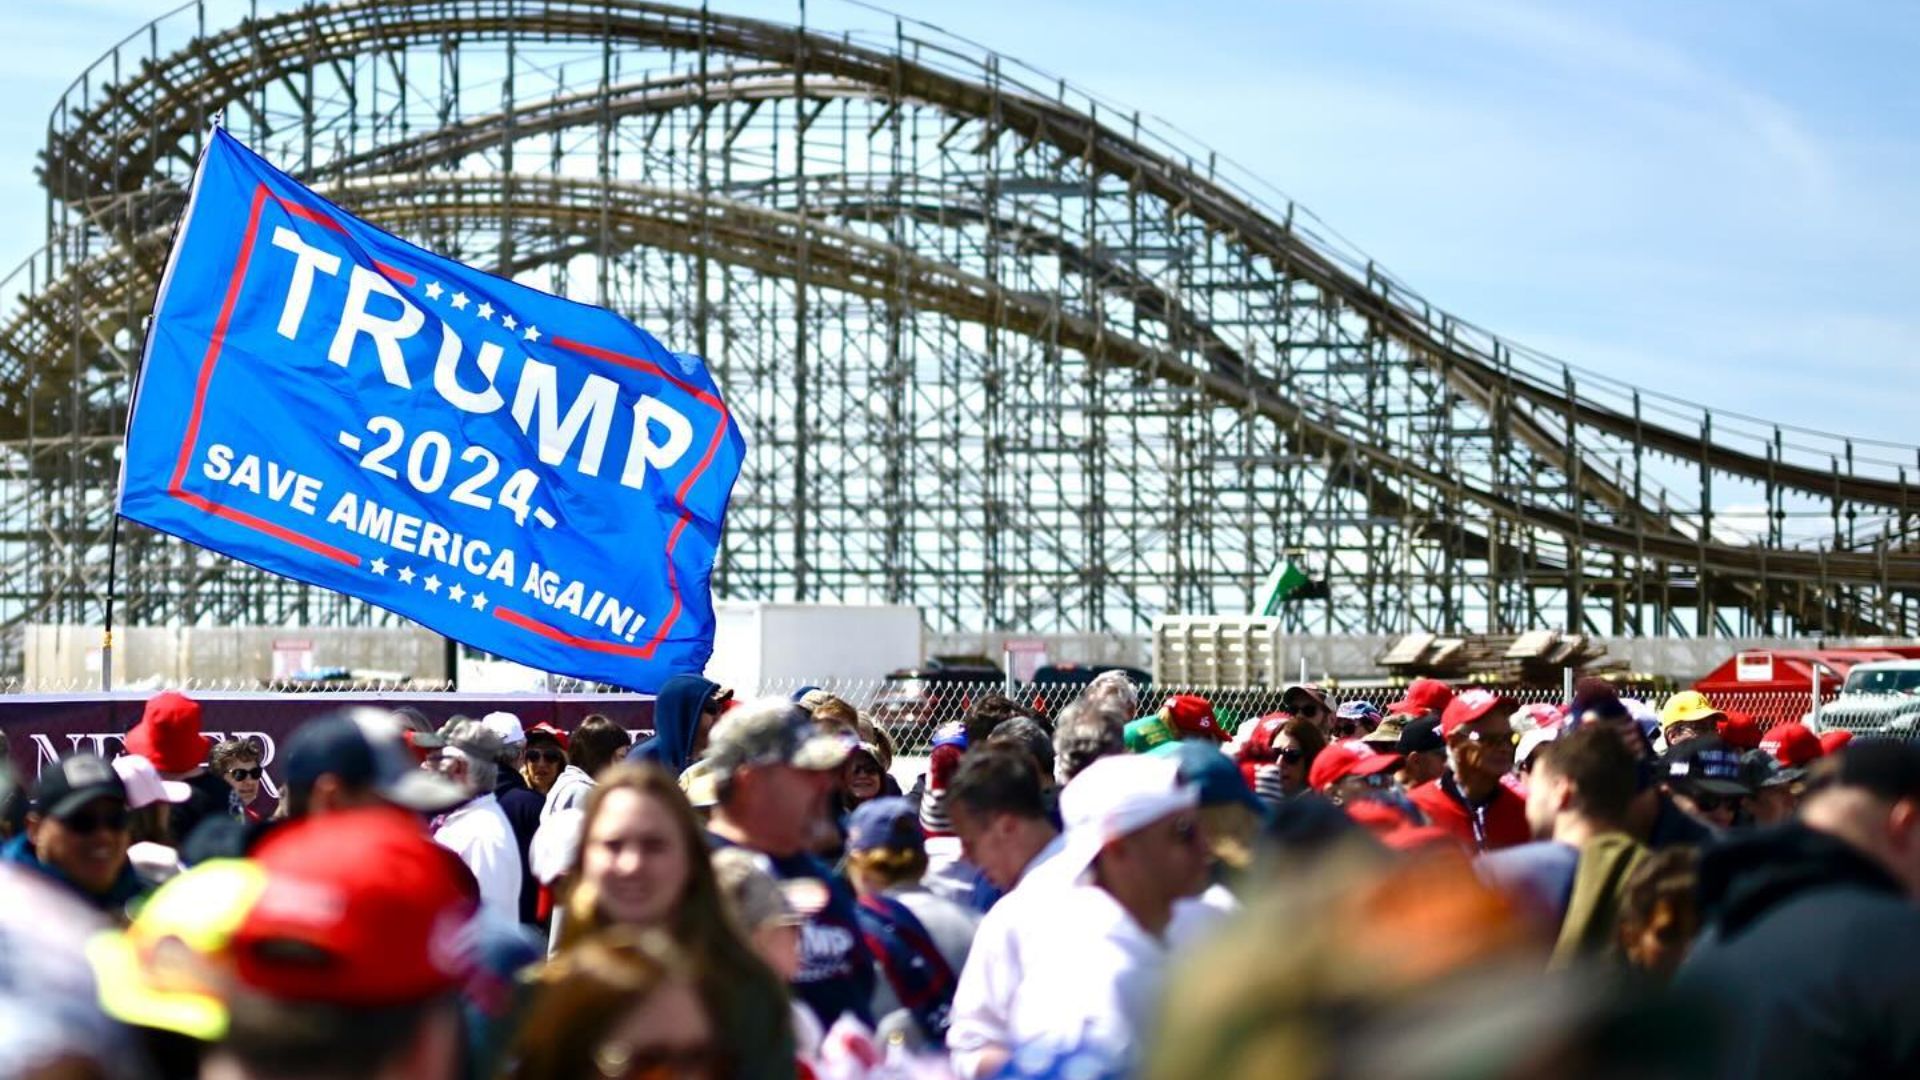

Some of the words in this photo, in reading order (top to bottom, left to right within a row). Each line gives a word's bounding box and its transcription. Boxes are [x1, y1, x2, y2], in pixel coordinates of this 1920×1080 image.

[272, 226, 693, 490] TRUMP
[203, 443, 324, 516] SAVE
[326, 491, 515, 587] AMERICA
[521, 562, 646, 643] AGAIN!
[338, 416, 557, 529] -2024-
